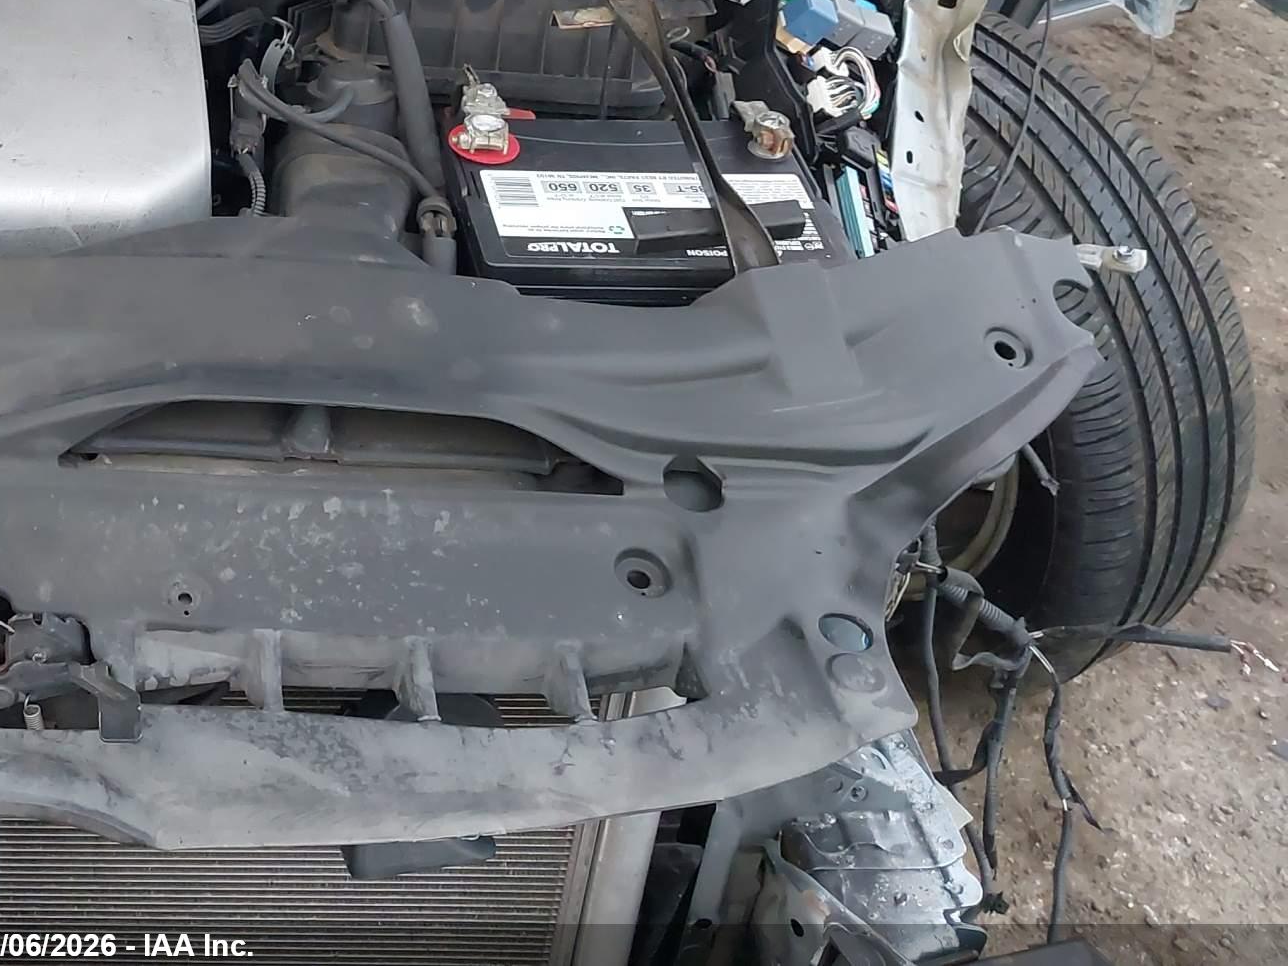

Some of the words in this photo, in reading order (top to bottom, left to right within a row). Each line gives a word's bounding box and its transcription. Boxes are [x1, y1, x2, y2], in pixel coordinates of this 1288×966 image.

[548, 182, 577, 192] 650
[589, 183, 618, 192] 520
[632, 185, 652, 193] 35
[527, 241, 620, 253] TOTALPRO
[686, 249, 729, 257] POISON
